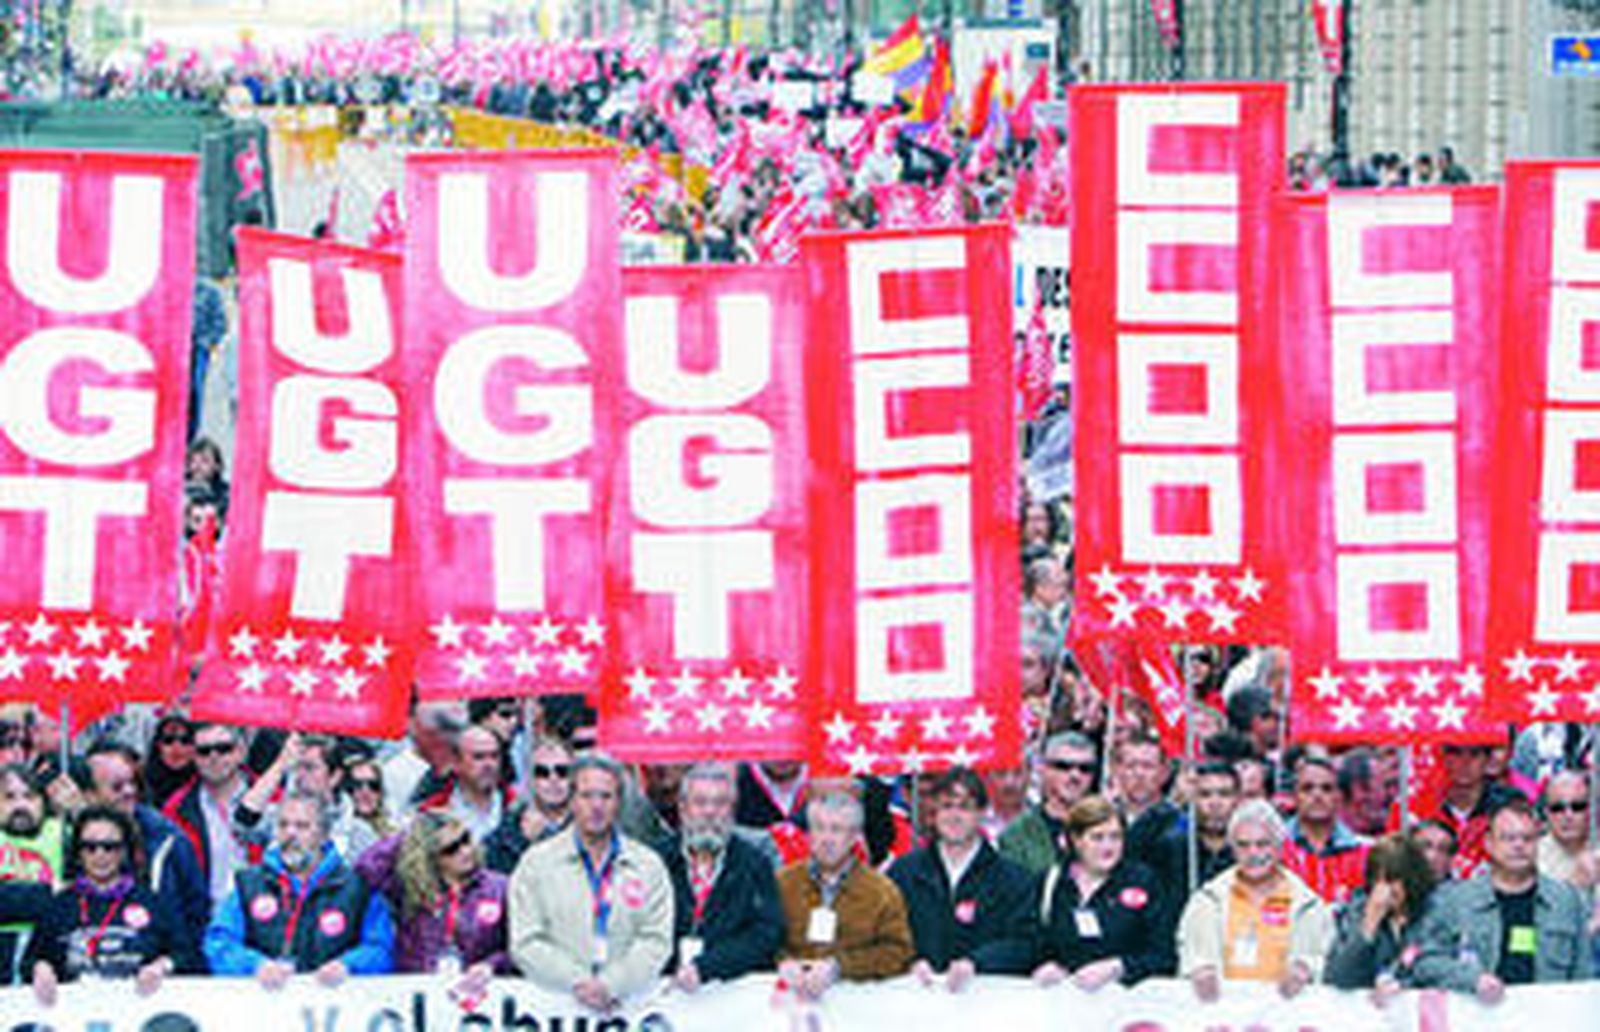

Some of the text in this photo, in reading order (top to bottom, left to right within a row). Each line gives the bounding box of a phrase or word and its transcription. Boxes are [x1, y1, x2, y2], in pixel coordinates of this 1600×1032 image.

[0, 171, 164, 612] UGT
[262, 257, 399, 621] UGT
[433, 171, 594, 613] UGT
[625, 293, 776, 660] UGT
[847, 236, 975, 704] CCOO
[1117, 93, 1243, 565] CCOO
[1327, 193, 1461, 661] CCOO
